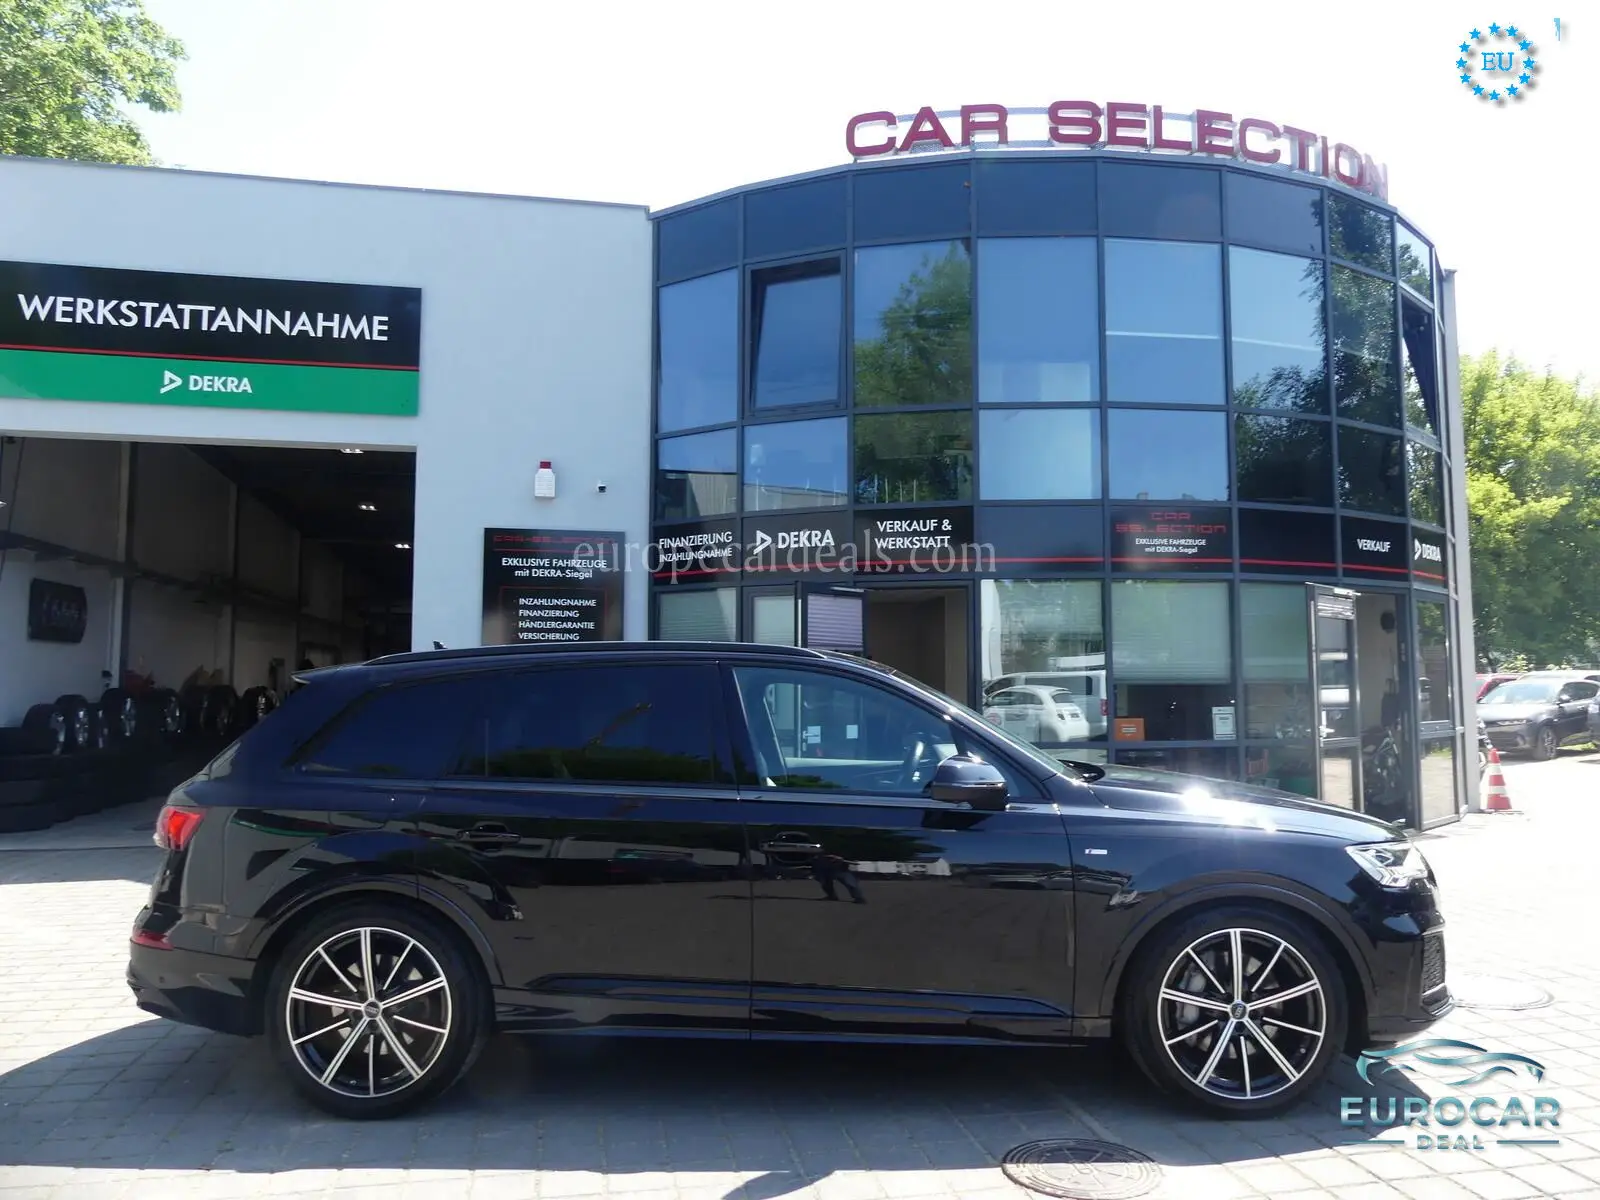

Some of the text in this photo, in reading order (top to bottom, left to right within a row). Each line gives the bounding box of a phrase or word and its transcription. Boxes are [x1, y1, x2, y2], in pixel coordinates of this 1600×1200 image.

[846, 100, 1389, 204] CAR SELECTION
[17, 293, 389, 341] WERKSTATTANNAHME
[189, 375, 252, 394] DEKRA
[877, 518, 953, 533] VERKAUF &
[658, 531, 733, 549] FINANZIERUNG
[777, 529, 835, 549] DEKRA
[874, 535, 951, 550] WERKSTATT
[1169, 538, 1207, 546] FAHRZEUGE
[1357, 538, 1392, 553] VERKAUF
[659, 547, 733, 562] INZAHLUNGNAHME
[1421, 543, 1442, 562] DEKRA
[501, 557, 608, 569] EXKLUSIVE FAHRZEUGE
[514, 569, 593, 579] mit DEKRA-Siegel
[518, 598, 597, 607] INZAHLUNGNAHME
[518, 609, 580, 618] FINANZIERUNG
[518, 620, 596, 630] HÄNDLERGARANTIE
[518, 632, 580, 641] VERSICHERUNG
